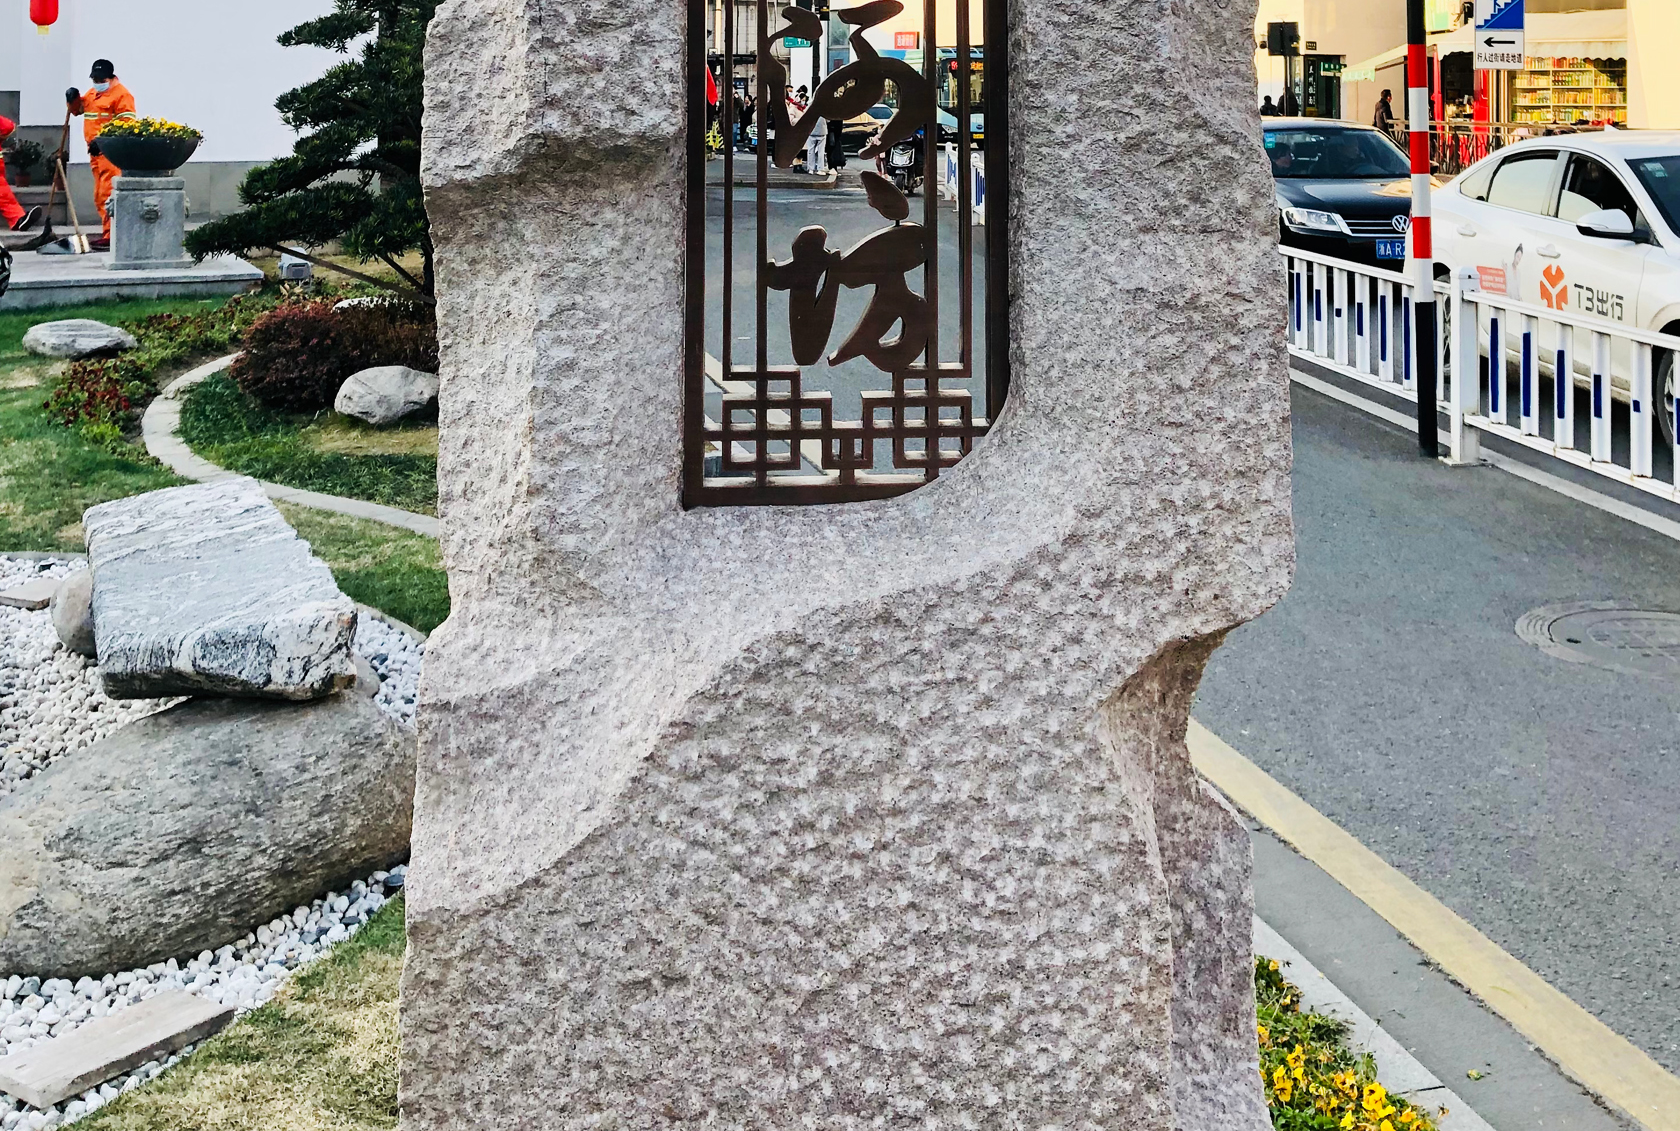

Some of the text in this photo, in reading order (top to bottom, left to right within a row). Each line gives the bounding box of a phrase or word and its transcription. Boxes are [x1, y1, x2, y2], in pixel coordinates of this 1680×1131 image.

[1477, 52, 1523, 64] 行人过街请走地道
[1573, 283, 1624, 321] T3出行
